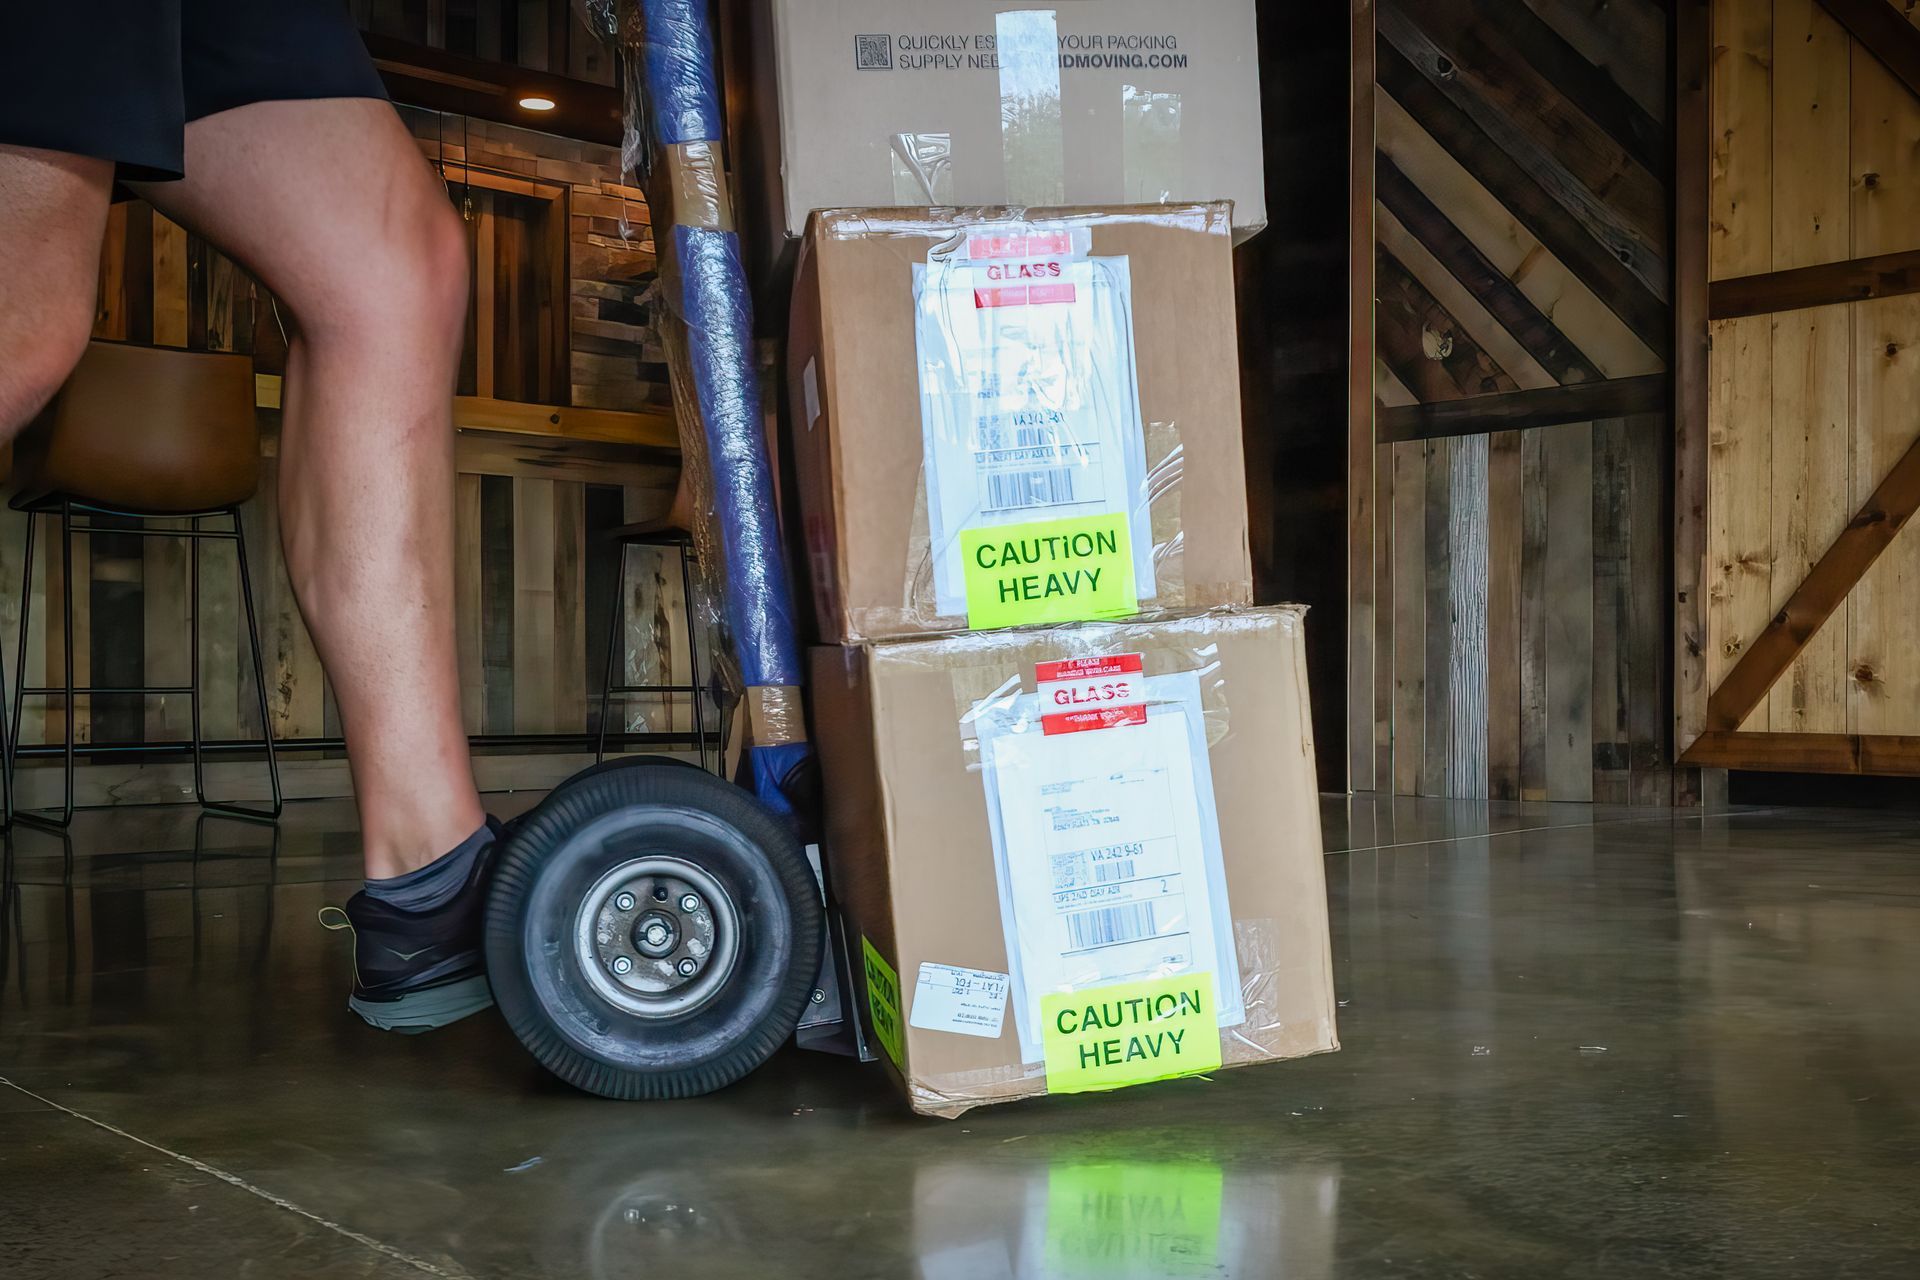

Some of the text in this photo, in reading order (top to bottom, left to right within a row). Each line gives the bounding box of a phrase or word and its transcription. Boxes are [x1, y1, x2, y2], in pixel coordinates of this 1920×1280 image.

[898, 34, 1178, 50] QUICKLY ES YOUR PACKING
[899, 53, 1188, 70] SUPPLY NEE DMOVING.COM
[987, 261, 1061, 280] GLASS
[975, 529, 1117, 569] CAUTION
[998, 567, 1102, 603] HEAVY
[1053, 682, 1130, 705] GLASS
[1056, 989, 1201, 1035] CAUTION
[1079, 1028, 1186, 1069] HEAVY
